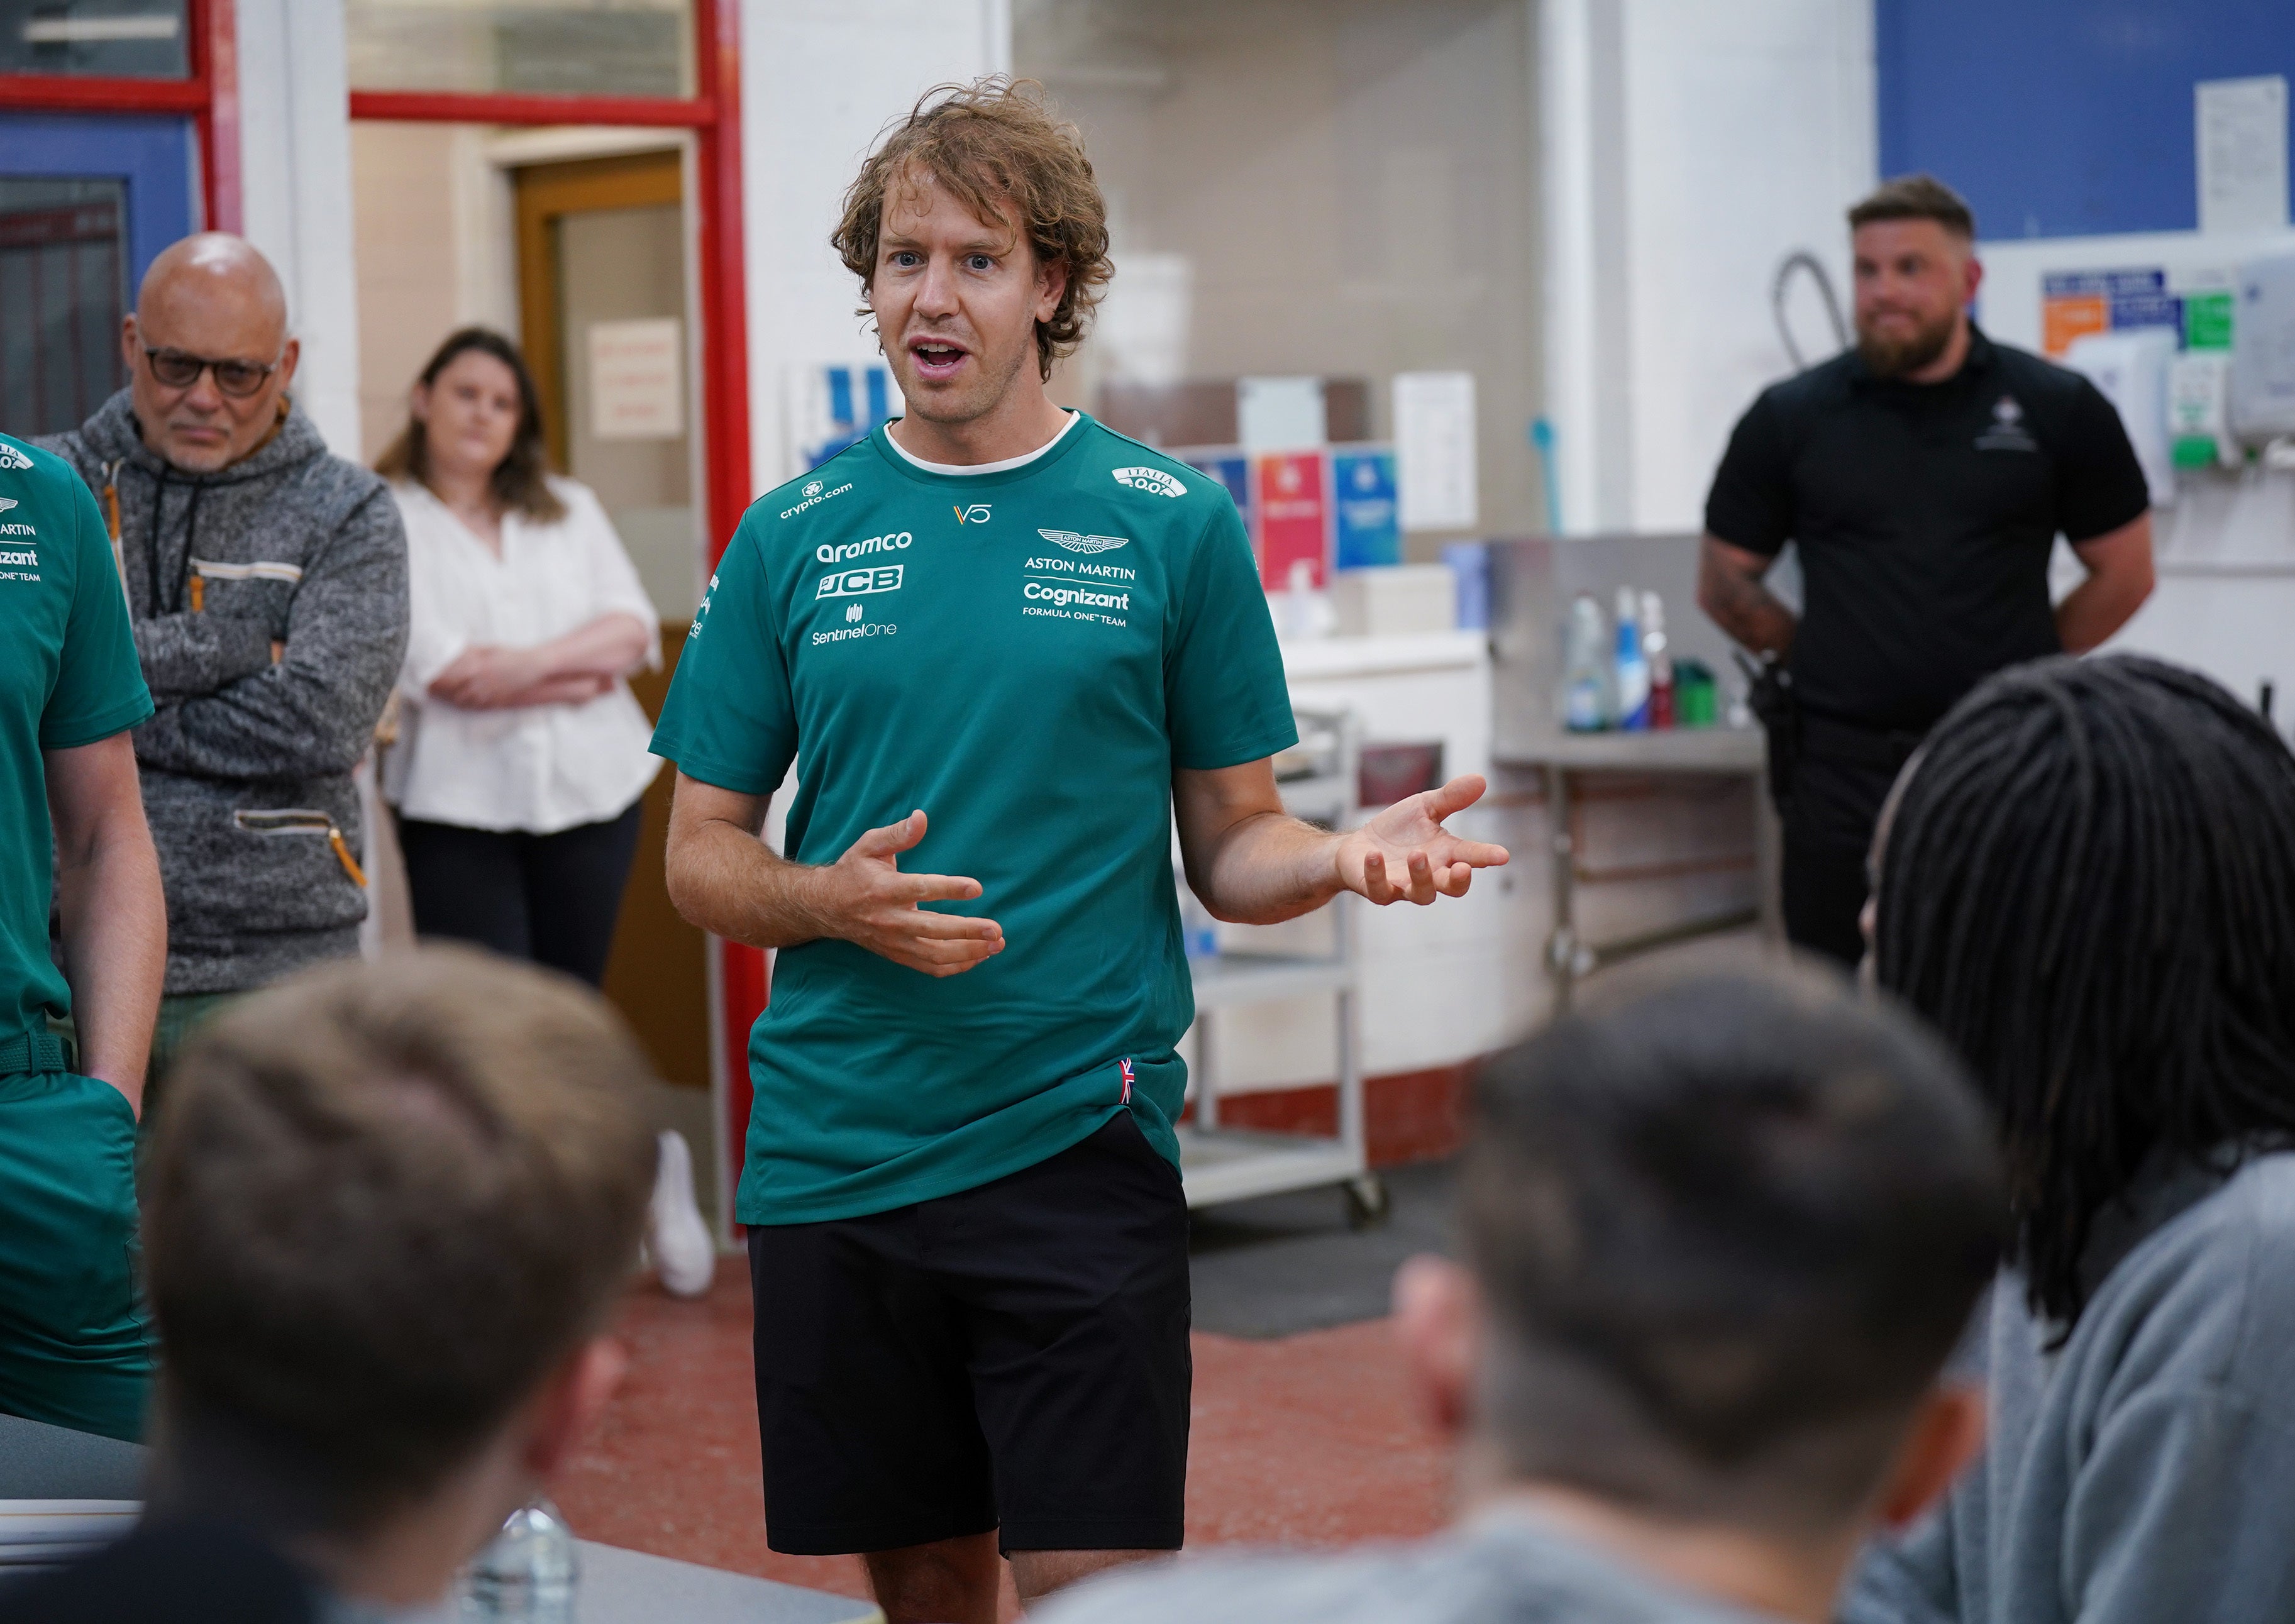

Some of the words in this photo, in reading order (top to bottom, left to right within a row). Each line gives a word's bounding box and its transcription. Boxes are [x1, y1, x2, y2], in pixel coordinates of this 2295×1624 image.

[1127, 468, 1173, 485] ITALIA
[780, 482, 853, 519] crypto.com
[816, 531, 912, 563] aramco
[19, 572, 41, 582] TEAM
[1024, 557, 1074, 572] ASTON
[1079, 564, 1136, 580] MARTIN
[818, 568, 900, 595] JCB
[1023, 582, 1129, 610] Cognizant
[1022, 607, 1071, 619] FORMULA
[1100, 616, 1126, 627] TEAM
[812, 622, 897, 646] SentinelOne
